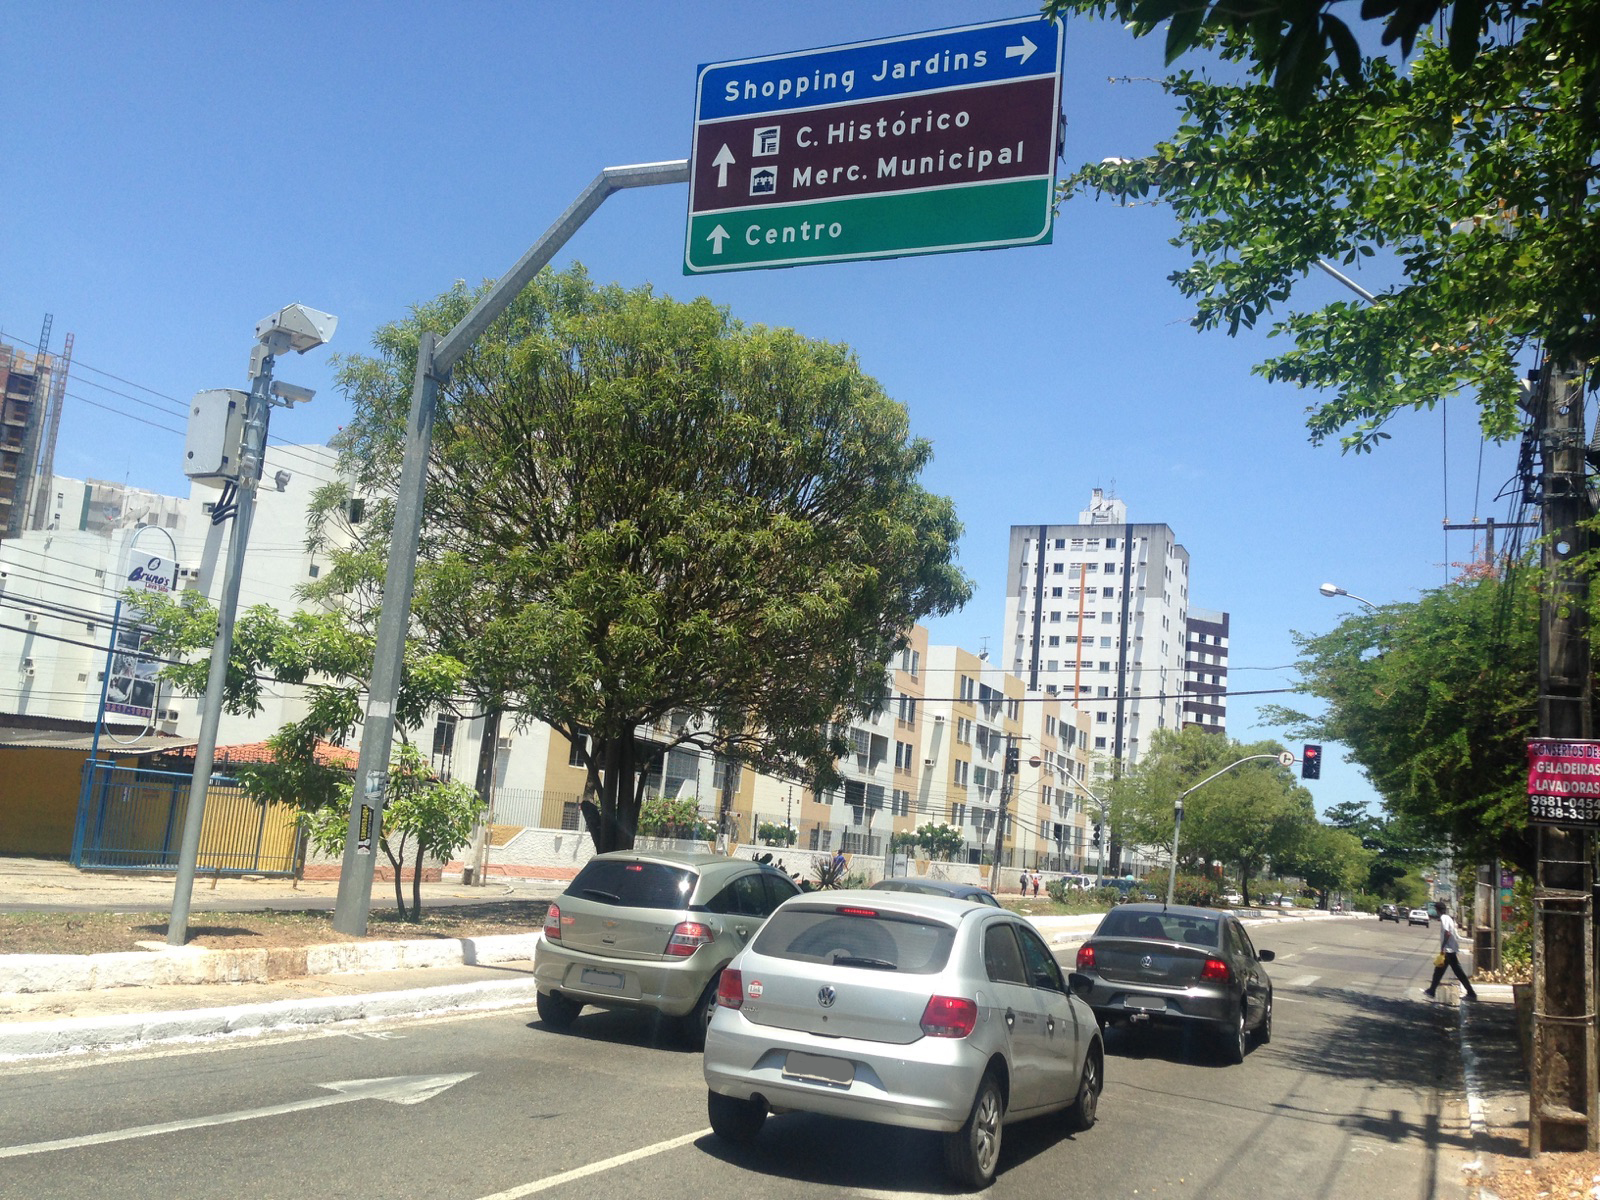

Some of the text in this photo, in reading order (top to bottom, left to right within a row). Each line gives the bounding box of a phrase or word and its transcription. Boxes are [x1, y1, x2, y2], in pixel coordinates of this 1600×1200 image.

[724, 49, 989, 102] Shopping Jardins
[795, 110, 971, 148] C. Histórico
[792, 140, 1024, 188] Merc. Municipal
[745, 221, 843, 247] Centro
[128, 567, 170, 586] Bruno's
[1533, 743, 1584, 757] CONSERTOS
[1536, 761, 1600, 776] GELADEIRAS
[1535, 779, 1600, 795] LAVADORAS
